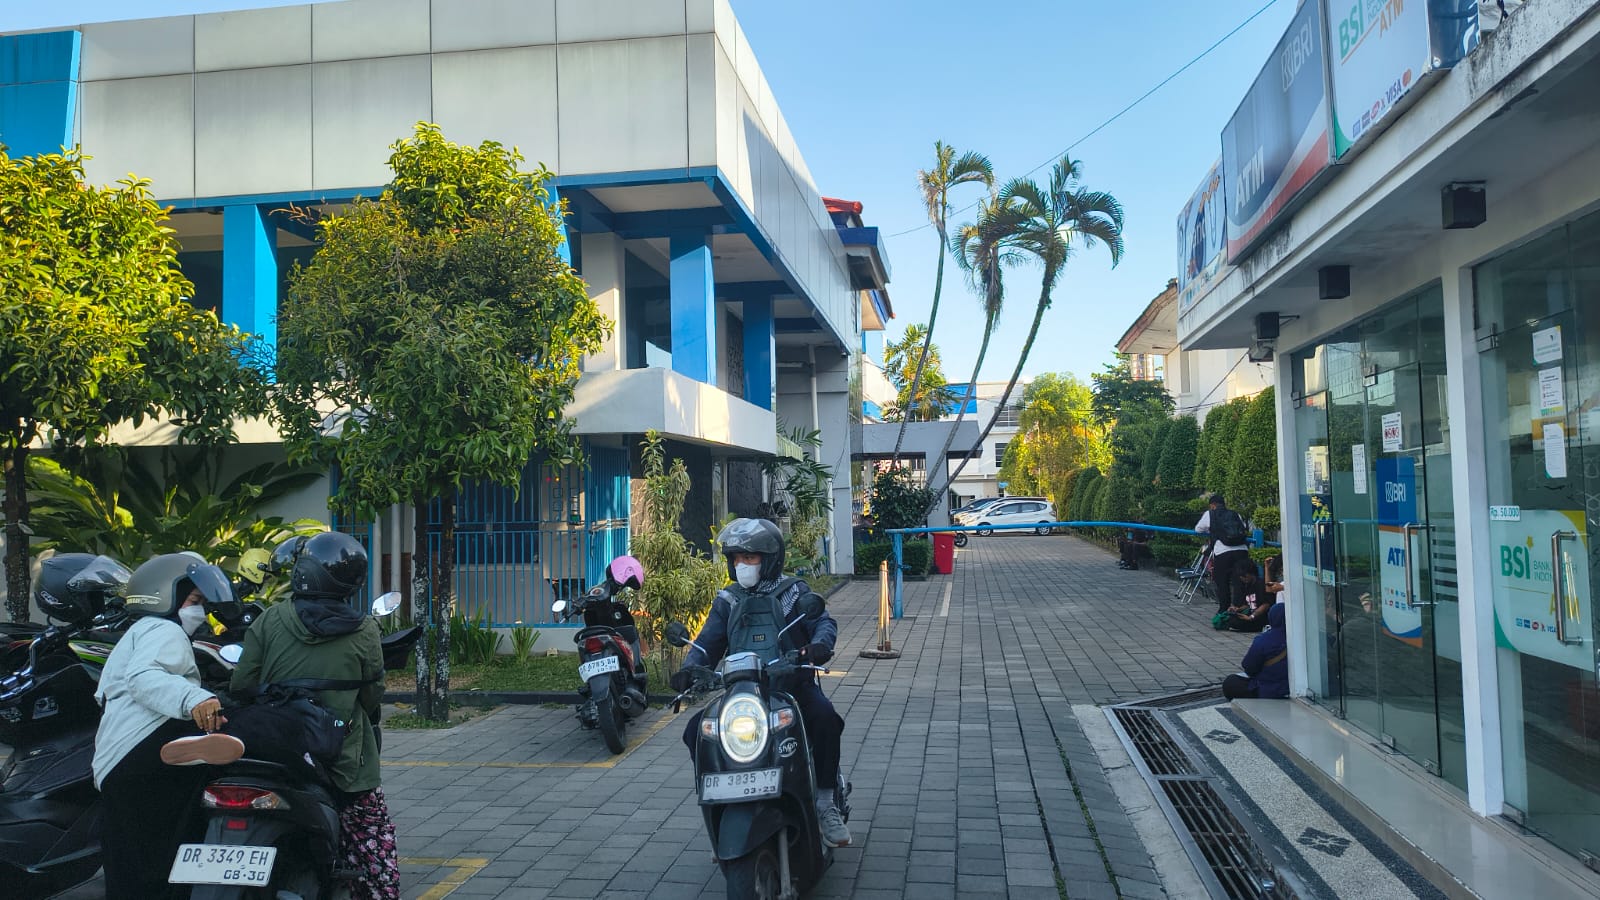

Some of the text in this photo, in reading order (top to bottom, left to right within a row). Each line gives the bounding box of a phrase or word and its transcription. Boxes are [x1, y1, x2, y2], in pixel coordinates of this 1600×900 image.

[1339, 0, 1364, 59] BSI
[1380, 0, 1404, 38] ATM
[1386, 79, 1402, 104] VISA
[1235, 145, 1265, 217] ATM
[1387, 547, 1405, 568] AT
[1500, 545, 1531, 580] BSI
[1549, 592, 1580, 619] AM
[182, 848, 269, 866] DR 3349 EH
